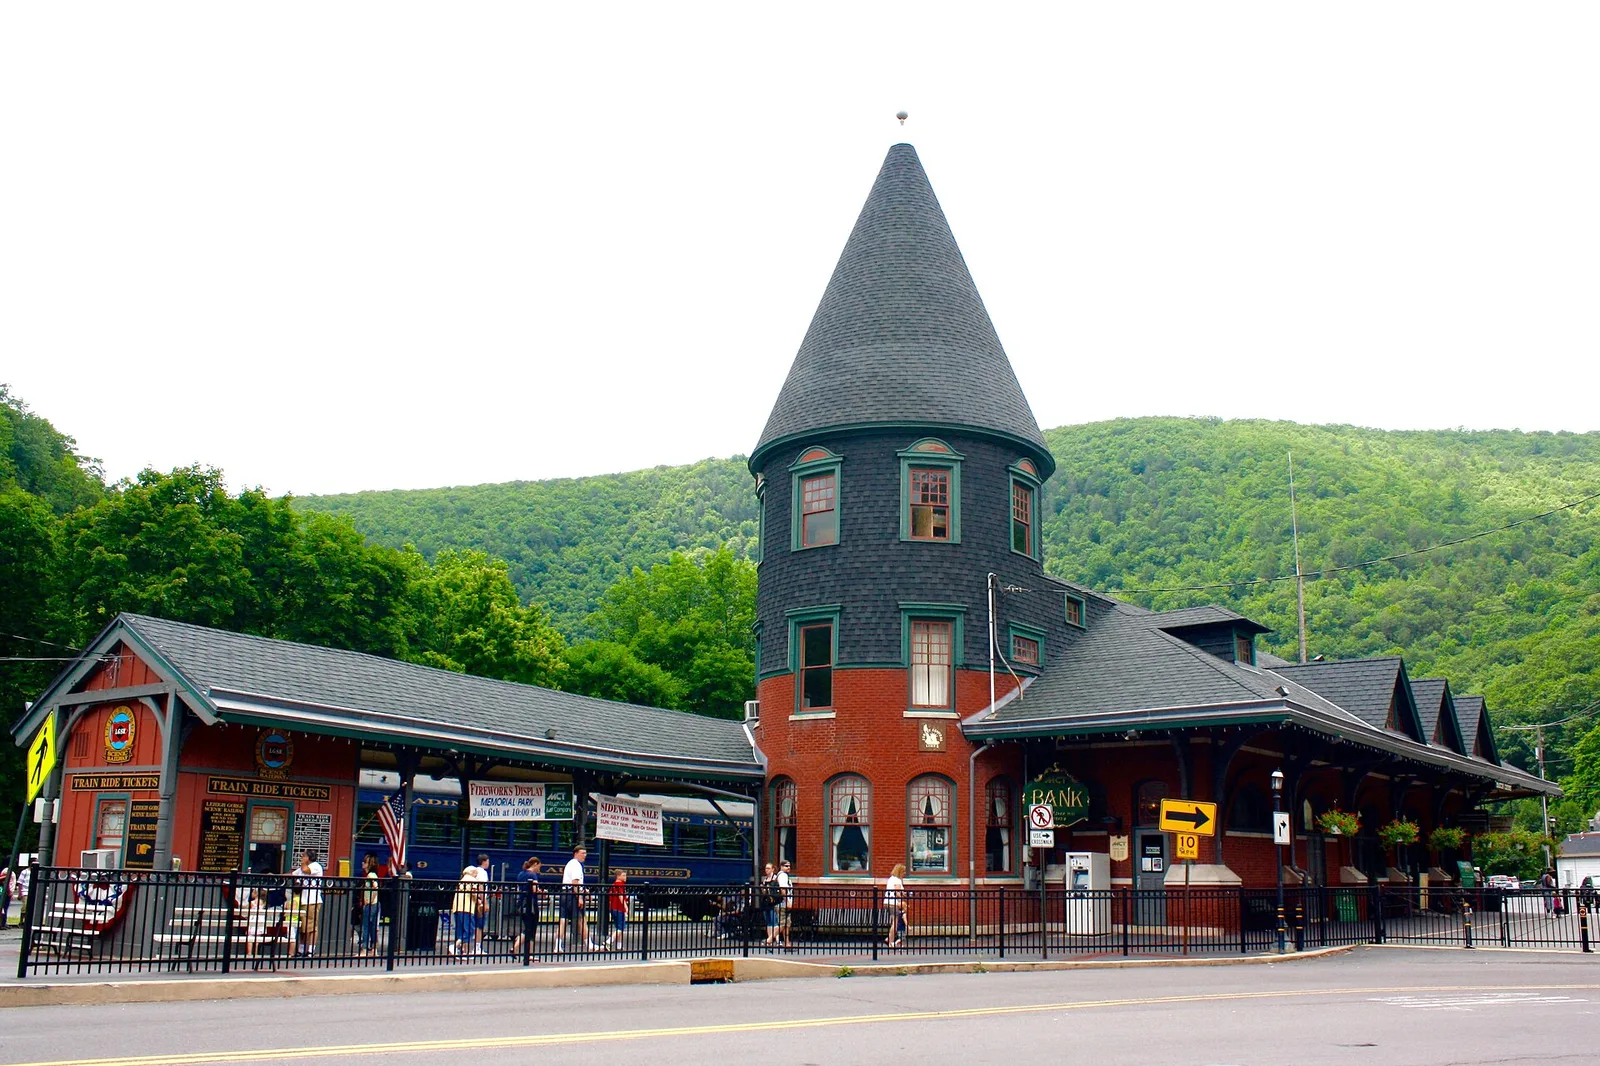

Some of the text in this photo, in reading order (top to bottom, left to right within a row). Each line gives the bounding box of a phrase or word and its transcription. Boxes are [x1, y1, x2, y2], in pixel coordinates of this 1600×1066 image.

[74, 777, 158, 788] TRAIN RIDE TICKETS
[211, 780, 328, 798] TRAIN RIDE TICKETS
[470, 783, 544, 796] FIREWORKS DISPLAY
[480, 798, 534, 806] MEMORIAL PARK
[1032, 787, 1083, 808] BANK
[473, 808, 486, 818] July
[488, 808, 500, 816] 6th
[512, 808, 530, 816] 10:00
[531, 808, 541, 816] PM
[600, 802, 638, 816] SIDEWALK
[642, 809, 659, 819] SALE
[1180, 836, 1195, 848] 10
